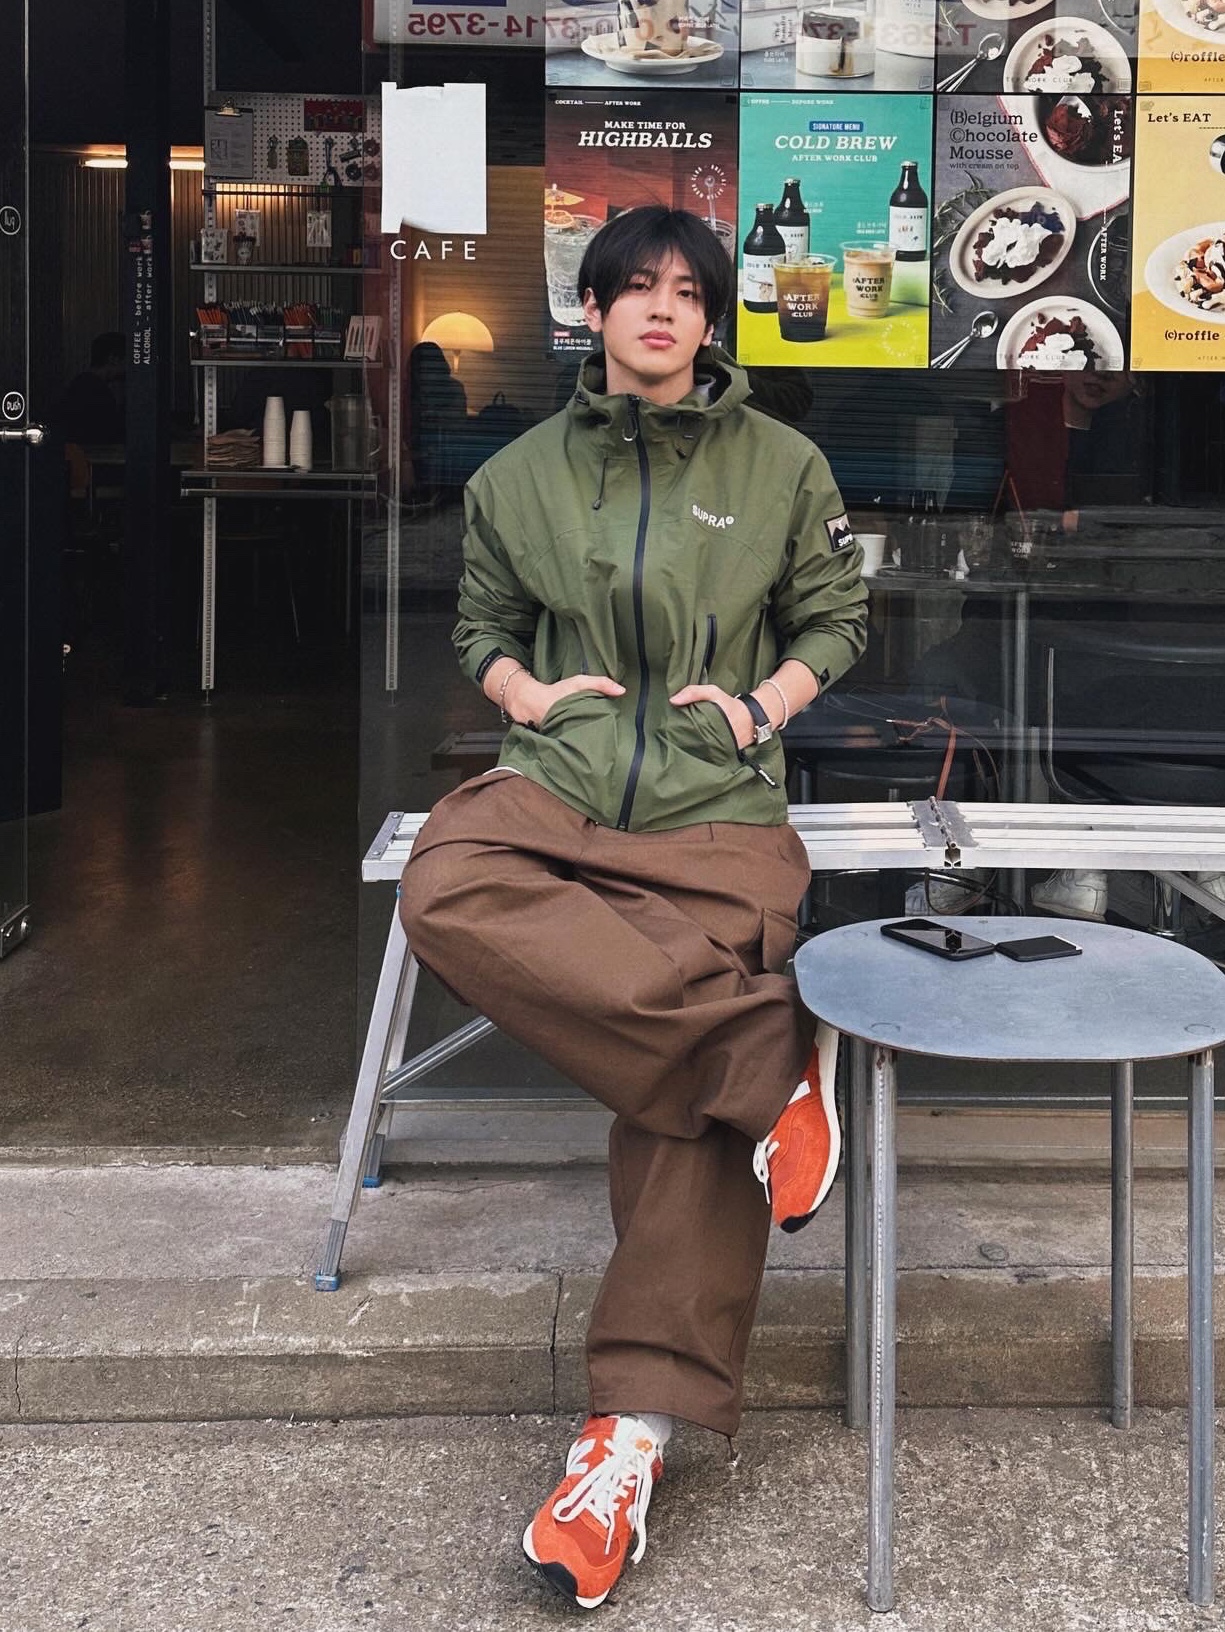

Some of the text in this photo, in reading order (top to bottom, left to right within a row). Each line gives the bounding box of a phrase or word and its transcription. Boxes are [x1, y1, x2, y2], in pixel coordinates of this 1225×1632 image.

[604, 121, 686, 130] MAKE TIME FOR
[1113, 109, 1124, 141] Let's
[1147, 112, 1212, 123] Let's EAT
[812, 123, 861, 131] SIGNATURE MENU
[578, 131, 713, 148] HIGHBALLS
[775, 135, 898, 151] COLD BREW
[792, 154, 878, 163] AFTER WORK CLUB
[950, 146, 1014, 160] Mousse
[950, 162, 967, 170] with
[1006, 163, 1020, 171] top
[390, 239, 476, 260] CAFE
[135, 256, 143, 277] work
[144, 283, 152, 310] after
[856, 285, 883, 293] WORK
[134, 282, 143, 316] before
[786, 293, 820, 302] AFTER
[787, 302, 818, 311] WORK
[133, 331, 141, 365] COFFEE
[143, 327, 151, 365] ALCOHOL
[692, 504, 727, 529] SUPRA
